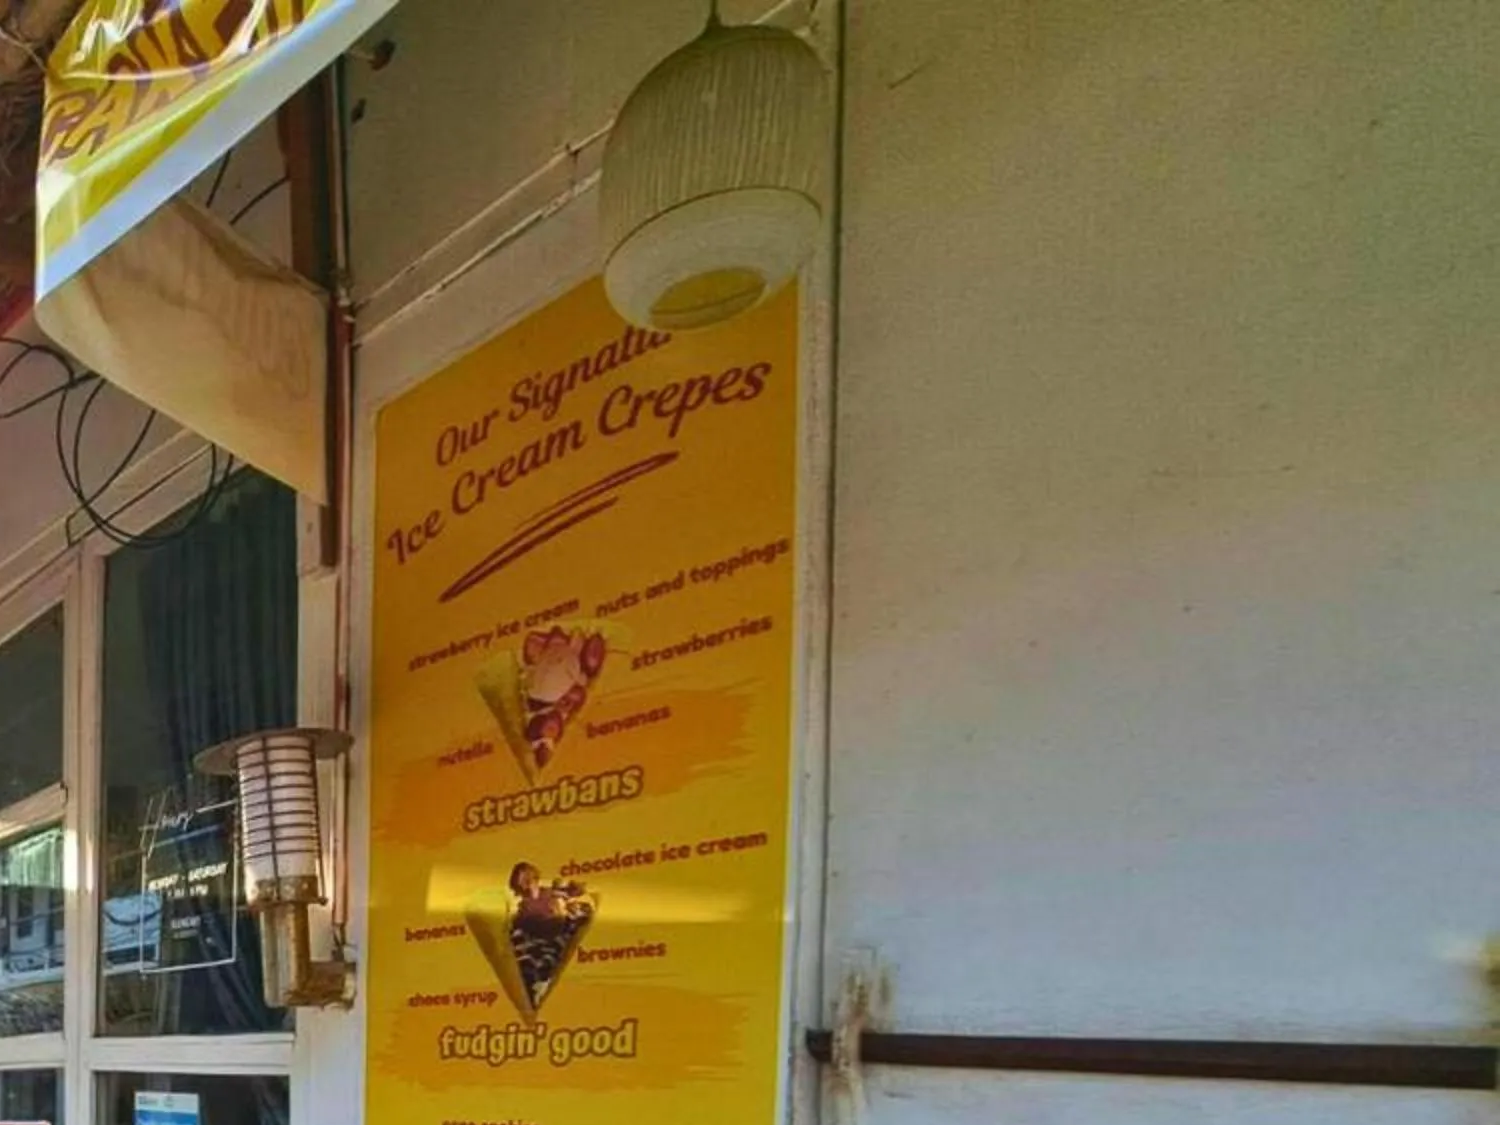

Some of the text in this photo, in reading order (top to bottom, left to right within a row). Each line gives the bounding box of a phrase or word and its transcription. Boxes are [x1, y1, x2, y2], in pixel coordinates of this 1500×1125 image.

[436, 326, 672, 467] Our Signatu
[387, 362, 772, 565] Ice Cream Crepes
[596, 538, 790, 618] nuts and toppings
[408, 599, 580, 672] strawberry ice cream
[630, 615, 773, 670] strawberries
[586, 704, 671, 739] bananas
[437, 740, 494, 769] nutella
[462, 765, 645, 833] strawbans
[559, 831, 768, 878] chocolate ice cream
[404, 922, 467, 942] bananas
[577, 941, 667, 964] brownies
[408, 988, 499, 1009] choco syrup
[439, 1018, 639, 1068] fudgin' good
